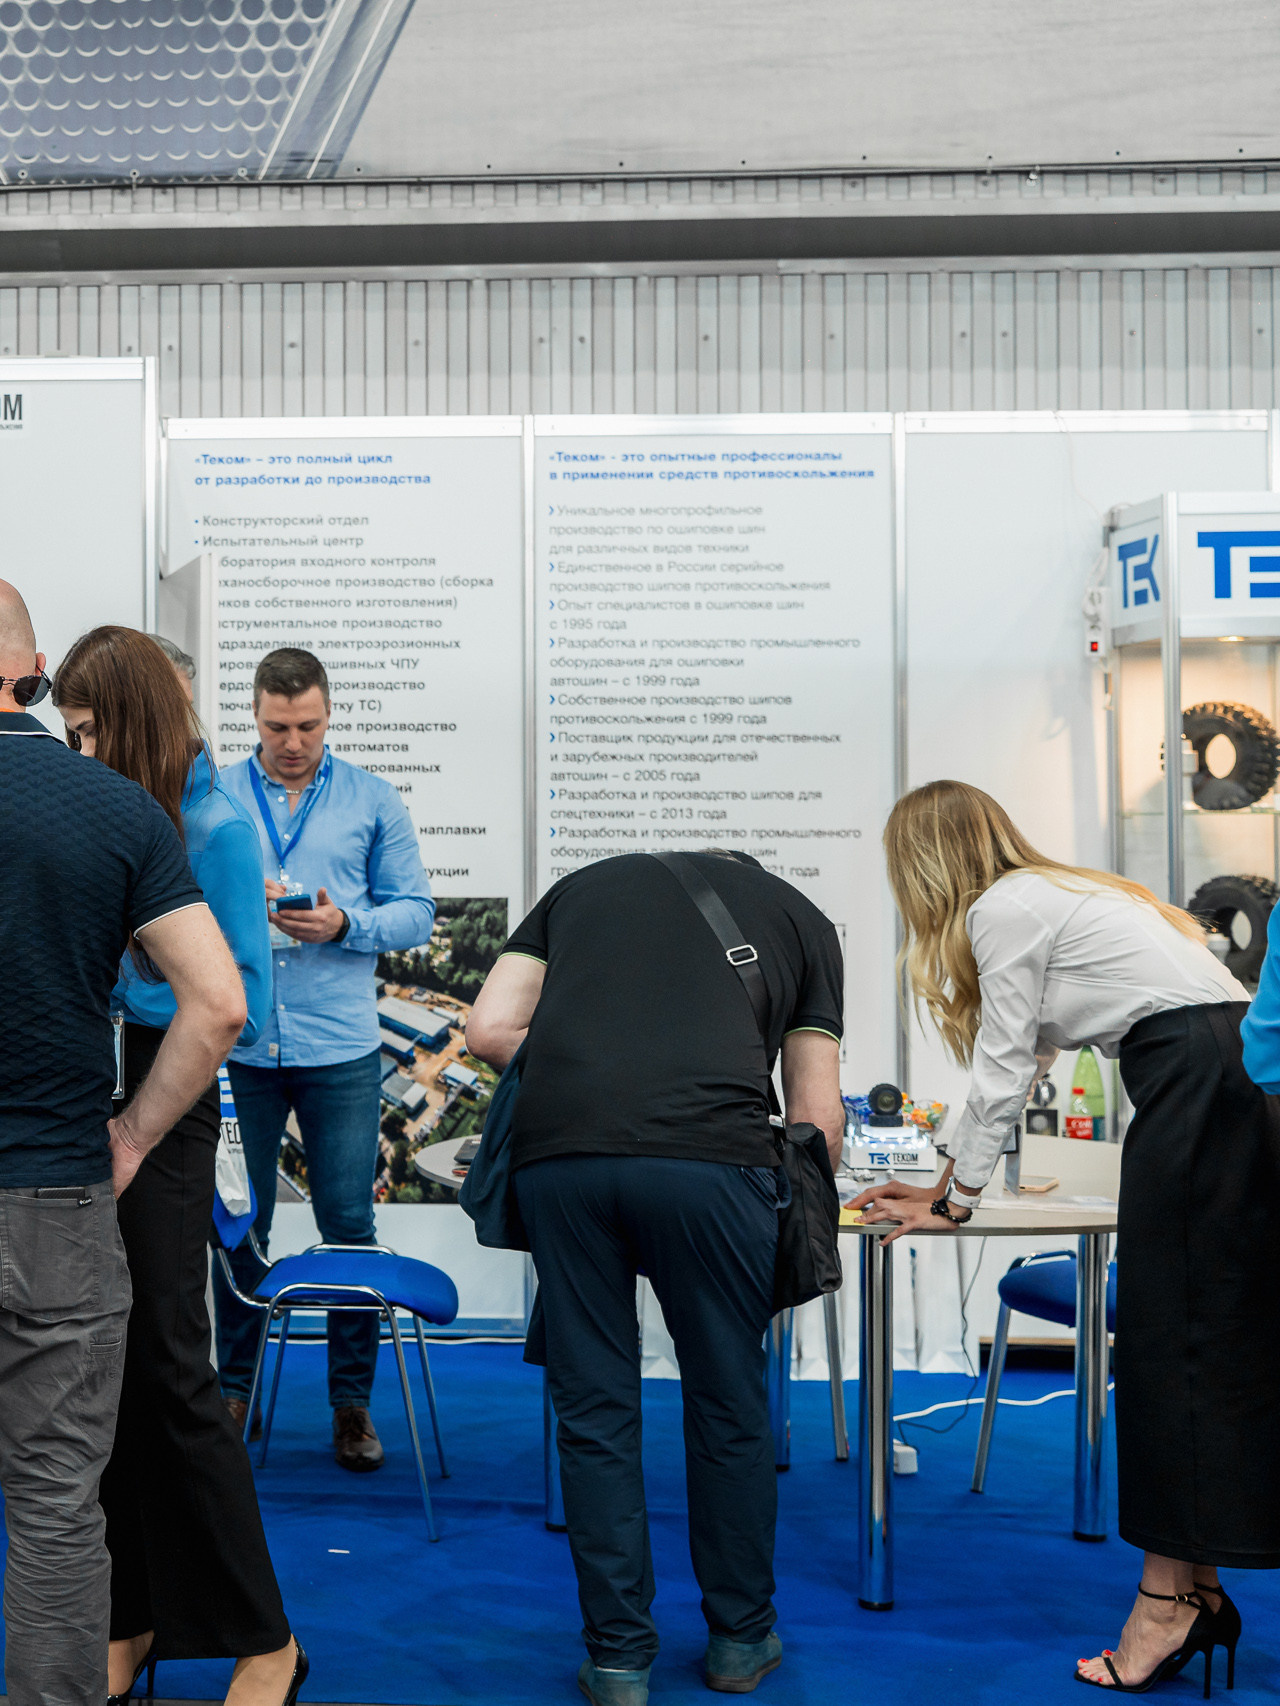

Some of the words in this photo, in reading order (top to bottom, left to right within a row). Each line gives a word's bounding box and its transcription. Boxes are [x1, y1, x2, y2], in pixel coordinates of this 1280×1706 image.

[268, 455, 293, 465] это
[296, 453, 353, 465] полный
[357, 455, 393, 465] цикл
[621, 453, 646, 463] это
[649, 453, 717, 463] опытные
[721, 450, 843, 464] профессионалы
[194, 476, 211, 486] от
[215, 474, 301, 488] разработки
[304, 475, 323, 487] до
[327, 475, 431, 487] производства
[562, 471, 654, 482] применении
[658, 470, 719, 482] средств
[723, 469, 875, 481] противоскольжения
[558, 504, 635, 516] Уникальное
[638, 504, 764, 518] многопрофильное
[202, 514, 324, 529] Конструкторский
[327, 516, 370, 527] отдел
[548, 525, 644, 537] производство
[646, 524, 664, 536] по
[666, 524, 735, 536] ошиповке
[737, 525, 766, 535] шин
[202, 535, 319, 548] Испытательный
[322, 537, 365, 549] центр
[548, 544, 574, 556] для
[576, 544, 649, 557] различных
[652, 544, 693, 555] видов
[696, 543, 750, 554] техники
[219, 555, 297, 570] боратория
[300, 557, 367, 568] входного
[370, 557, 437, 569] контроля
[558, 561, 652, 574] Единственное
[667, 560, 718, 573] России
[719, 560, 785, 575] серийное
[1197, 530, 1280, 599] ТЕ
[218, 575, 331, 590] ханосборочное
[335, 577, 436, 590] производство
[439, 575, 495, 590] (сборка
[548, 581, 644, 594] производство
[646, 581, 692, 592] шипов
[694, 581, 832, 593] противоскольжения
[254, 596, 353, 609] собственного
[355, 596, 458, 610] изготовления)
[558, 599, 592, 611] Опыт
[596, 600, 691, 612] специалистов
[705, 600, 774, 611] ошиповке
[776, 600, 805, 611] шин
[217, 619, 338, 632] струментальное
[341, 619, 443, 631] производство
[562, 617, 594, 630] 1995
[596, 619, 628, 632] года
[218, 640, 313, 652] дразделение
[317, 639, 461, 652] электроэрозионных
[557, 636, 637, 650] Разработка
[651, 638, 747, 651] производство
[749, 638, 862, 650] промышленного
[390, 657, 420, 670] ЧПУ
[549, 656, 646, 671] оборудования
[648, 657, 674, 669] для
[676, 657, 745, 668] ошиповки
[549, 676, 608, 687] автошин
[636, 674, 667, 687] 1999
[669, 676, 701, 689] года
[358, 699, 383, 713] ТС)
[557, 693, 647, 706] Собственное
[650, 695, 746, 708] производство
[748, 695, 793, 706] шипов
[549, 714, 687, 726] противоскольжения
[702, 712, 734, 725] 1999
[736, 714, 768, 726] года
[356, 722, 458, 735] производство
[559, 732, 633, 744] Поставщик
[637, 733, 710, 746] продукции
[711, 733, 737, 745] для
[739, 733, 842, 744] отечественных
[334, 743, 409, 753] автоматов
[562, 751, 645, 765] зарубежных
[648, 750, 759, 764] производителей
[364, 763, 441, 774] ированных
[550, 771, 609, 782] автошин
[634, 769, 668, 782] 2005
[670, 771, 701, 784] года
[559, 789, 636, 802] Разработка
[652, 790, 748, 803] производство
[750, 790, 795, 801] шипов
[797, 790, 823, 802] для
[549, 809, 635, 821] спецтехники
[661, 807, 694, 820] 2013
[697, 809, 728, 821] года
[419, 826, 487, 836] наплавки
[559, 827, 637, 840] Разработка
[652, 828, 748, 841] производство
[750, 828, 862, 840] промышленного
[426, 867, 469, 879] укции
[789, 866, 820, 879] года
